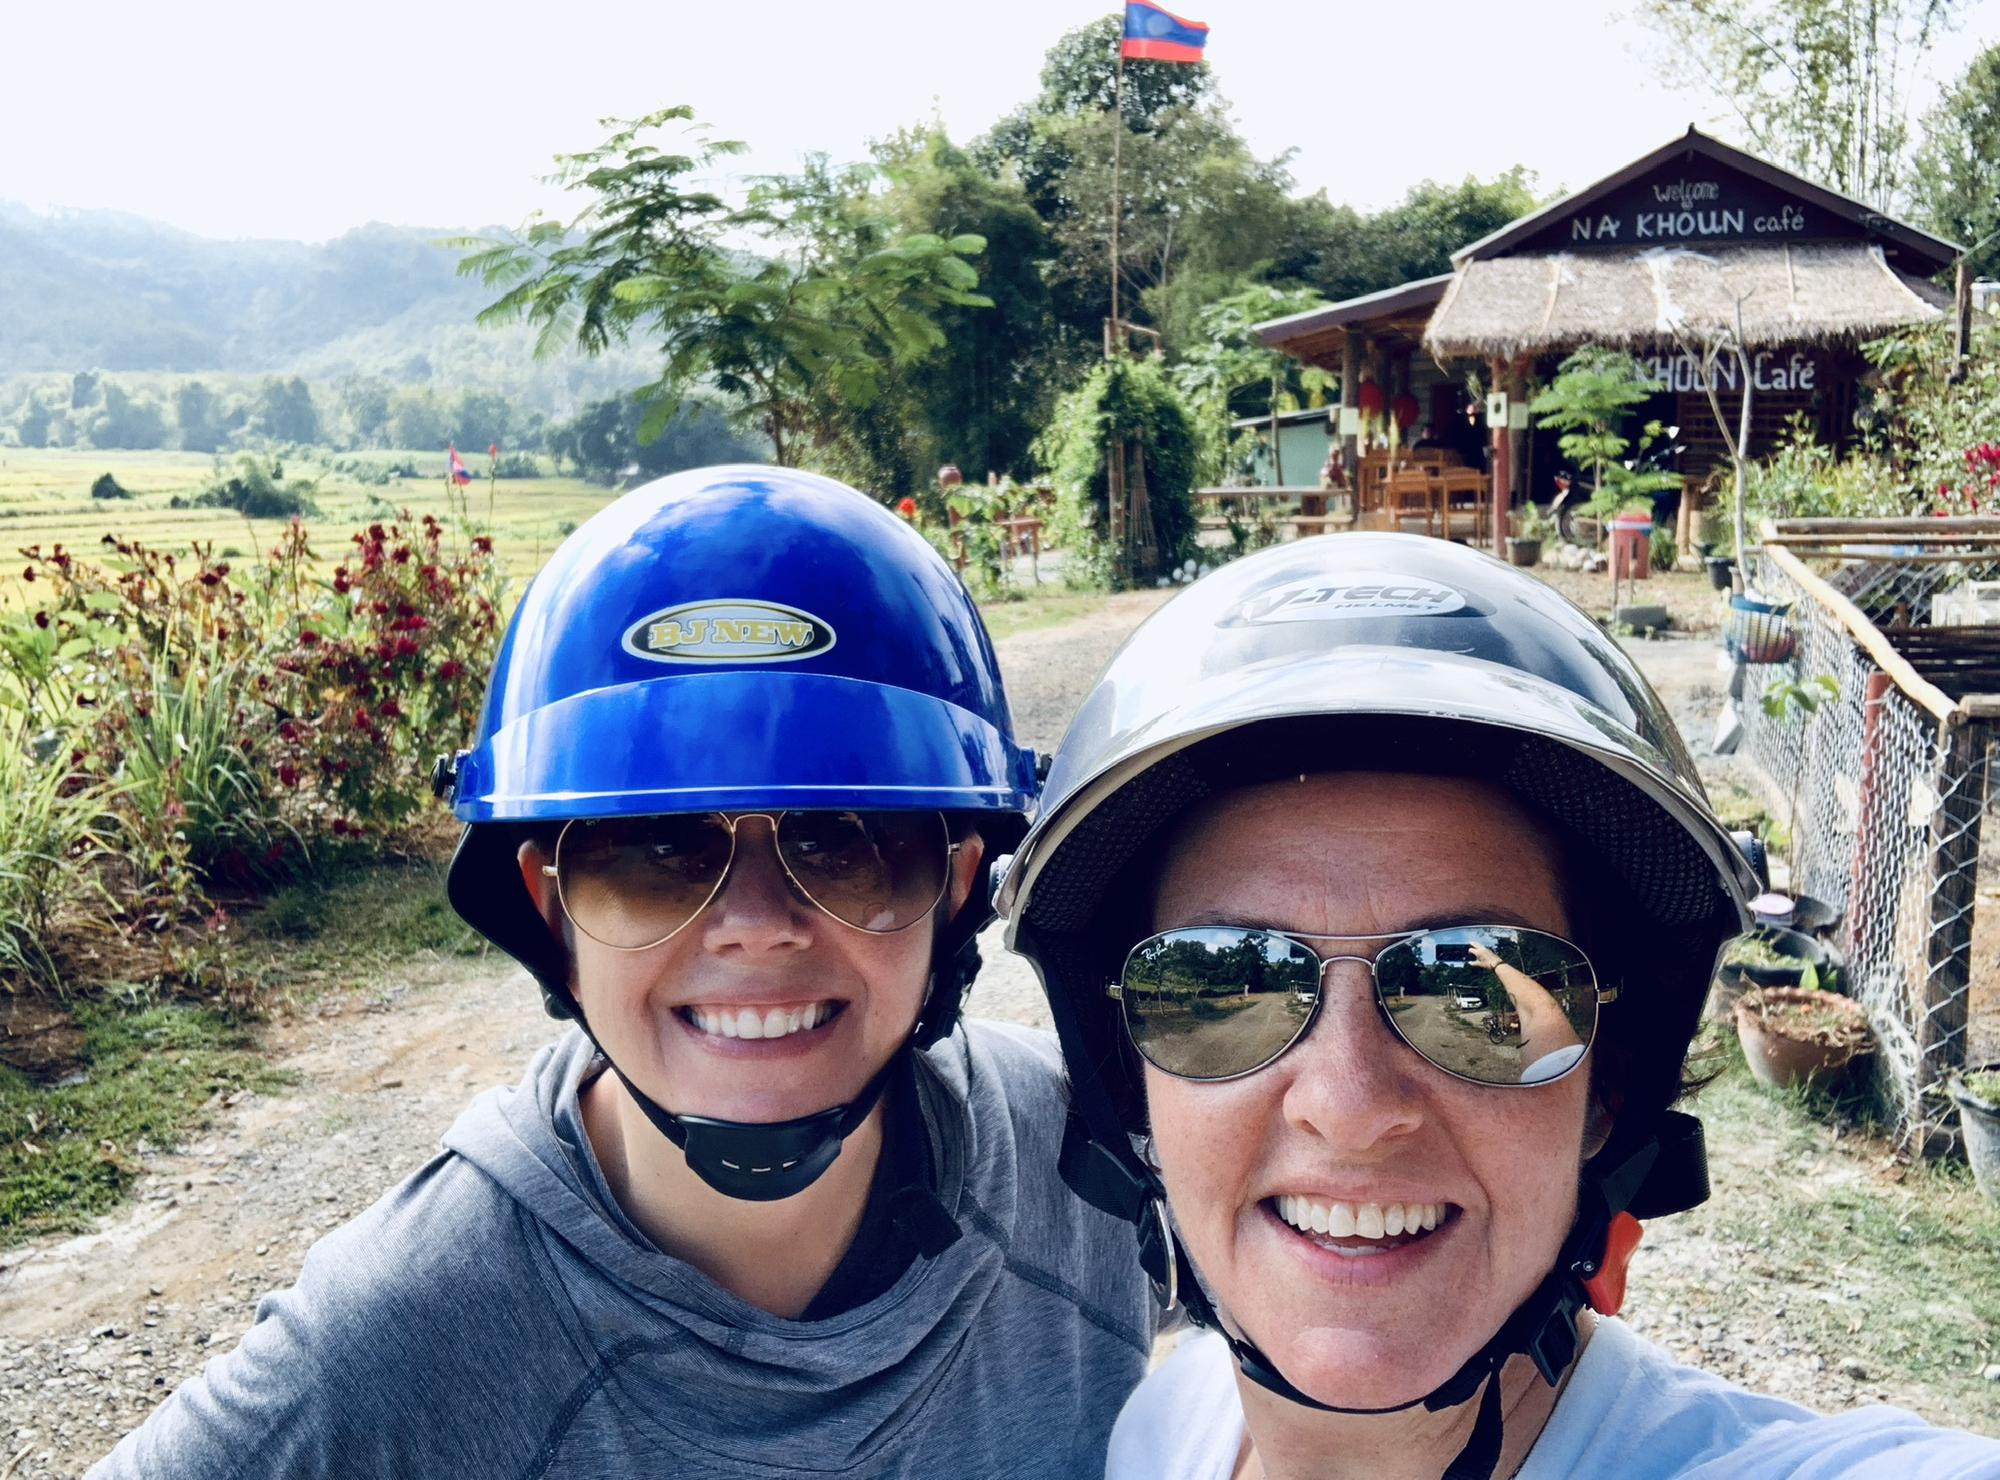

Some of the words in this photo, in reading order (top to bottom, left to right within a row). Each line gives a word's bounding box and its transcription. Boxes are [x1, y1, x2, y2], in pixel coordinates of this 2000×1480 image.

[1572, 214, 1620, 240] NA
[1636, 209, 1744, 237] KHOUN
[1753, 351, 1815, 391] Café
[649, 620, 708, 649] BJ
[712, 618, 813, 646] NEW
